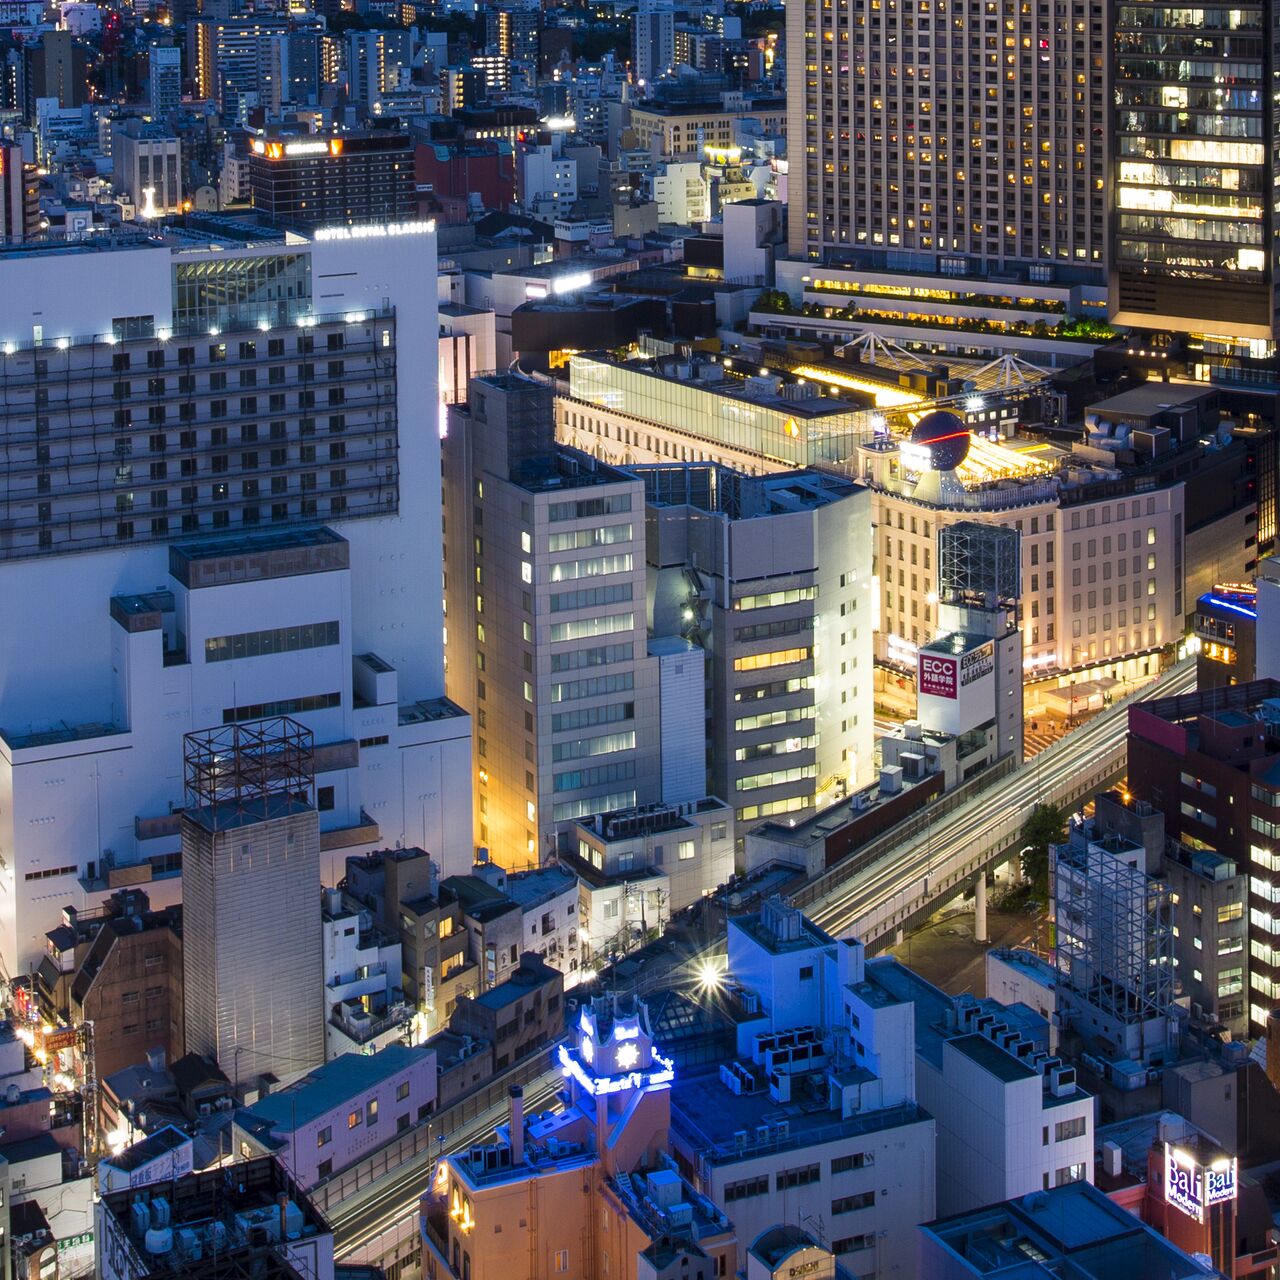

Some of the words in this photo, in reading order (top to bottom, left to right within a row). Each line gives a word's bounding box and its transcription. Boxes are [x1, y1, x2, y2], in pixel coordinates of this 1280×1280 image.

[74, 219, 86, 232] P
[314, 227, 351, 241] HOTEL
[351, 224, 387, 238] ROYAL
[387, 221, 436, 236] CLASSIC
[923, 658, 954, 675] ECC
[923, 671, 954, 686] 外語学院
[1168, 1155, 1204, 1201] Bali
[1205, 1164, 1236, 1191] Bali
[1169, 1184, 1204, 1215] Modern
[1208, 1187, 1234, 1200] Modern
